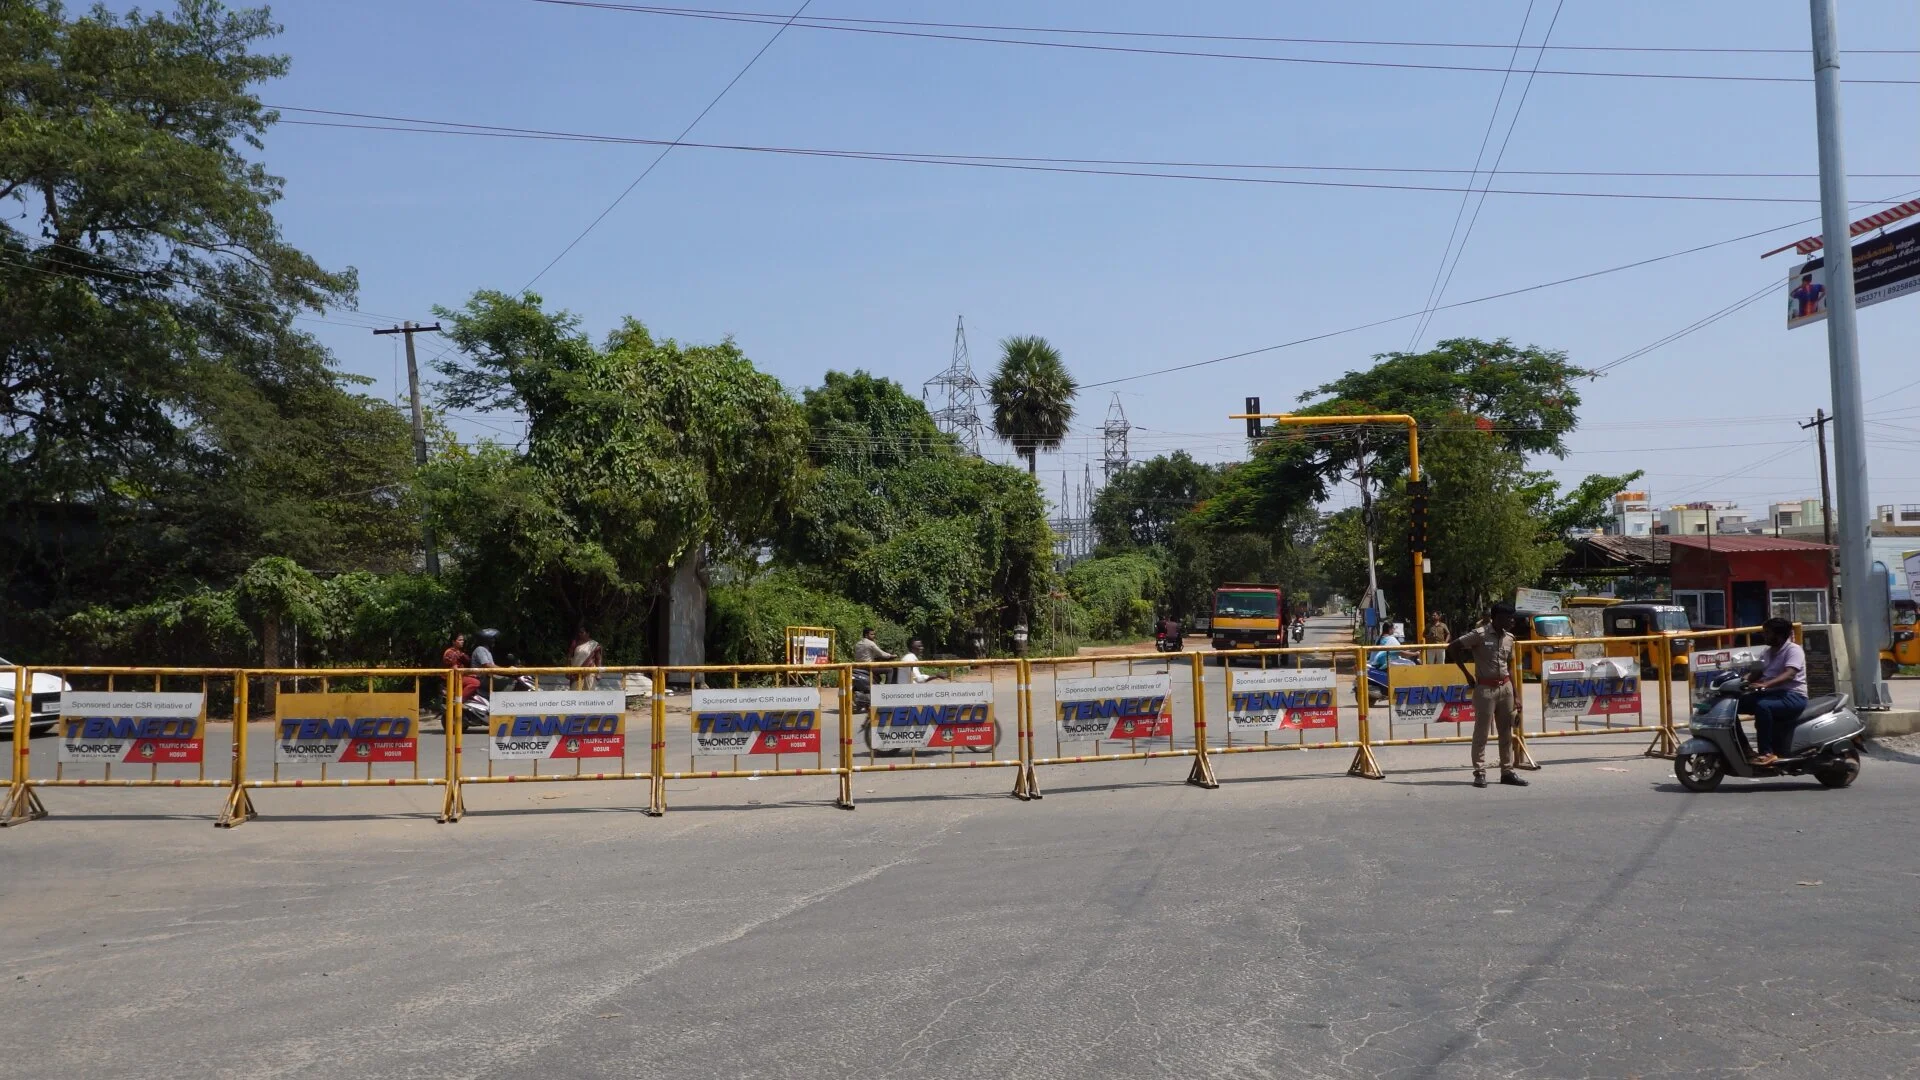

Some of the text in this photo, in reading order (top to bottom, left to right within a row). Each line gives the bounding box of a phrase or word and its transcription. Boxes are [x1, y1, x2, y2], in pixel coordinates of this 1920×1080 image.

[1699, 655, 1706, 664] NO
[1550, 662, 1559, 670] NO
[1560, 661, 1583, 670] PARKING
[1394, 685, 1474, 705] TENNEC
[702, 697, 737, 705] Sponsored
[1232, 690, 1332, 711] TENNECO
[71, 701, 111, 709] Sponsored
[185, 702, 193, 710] of
[876, 704, 988, 726] TENNECO
[1400, 707, 1432, 717] MONROE
[697, 711, 815, 733] TENNECO
[1240, 715, 1272, 724] MONROE
[281, 717, 411, 740] TENNECO
[1070, 724, 1104, 733] MONROE
[884, 731, 921, 740] MONROE
[503, 741, 543, 750] MONROE
[704, 737, 742, 746] MONROE
[72, 744, 116, 754] MONROE
[288, 745, 332, 754] MONROE
